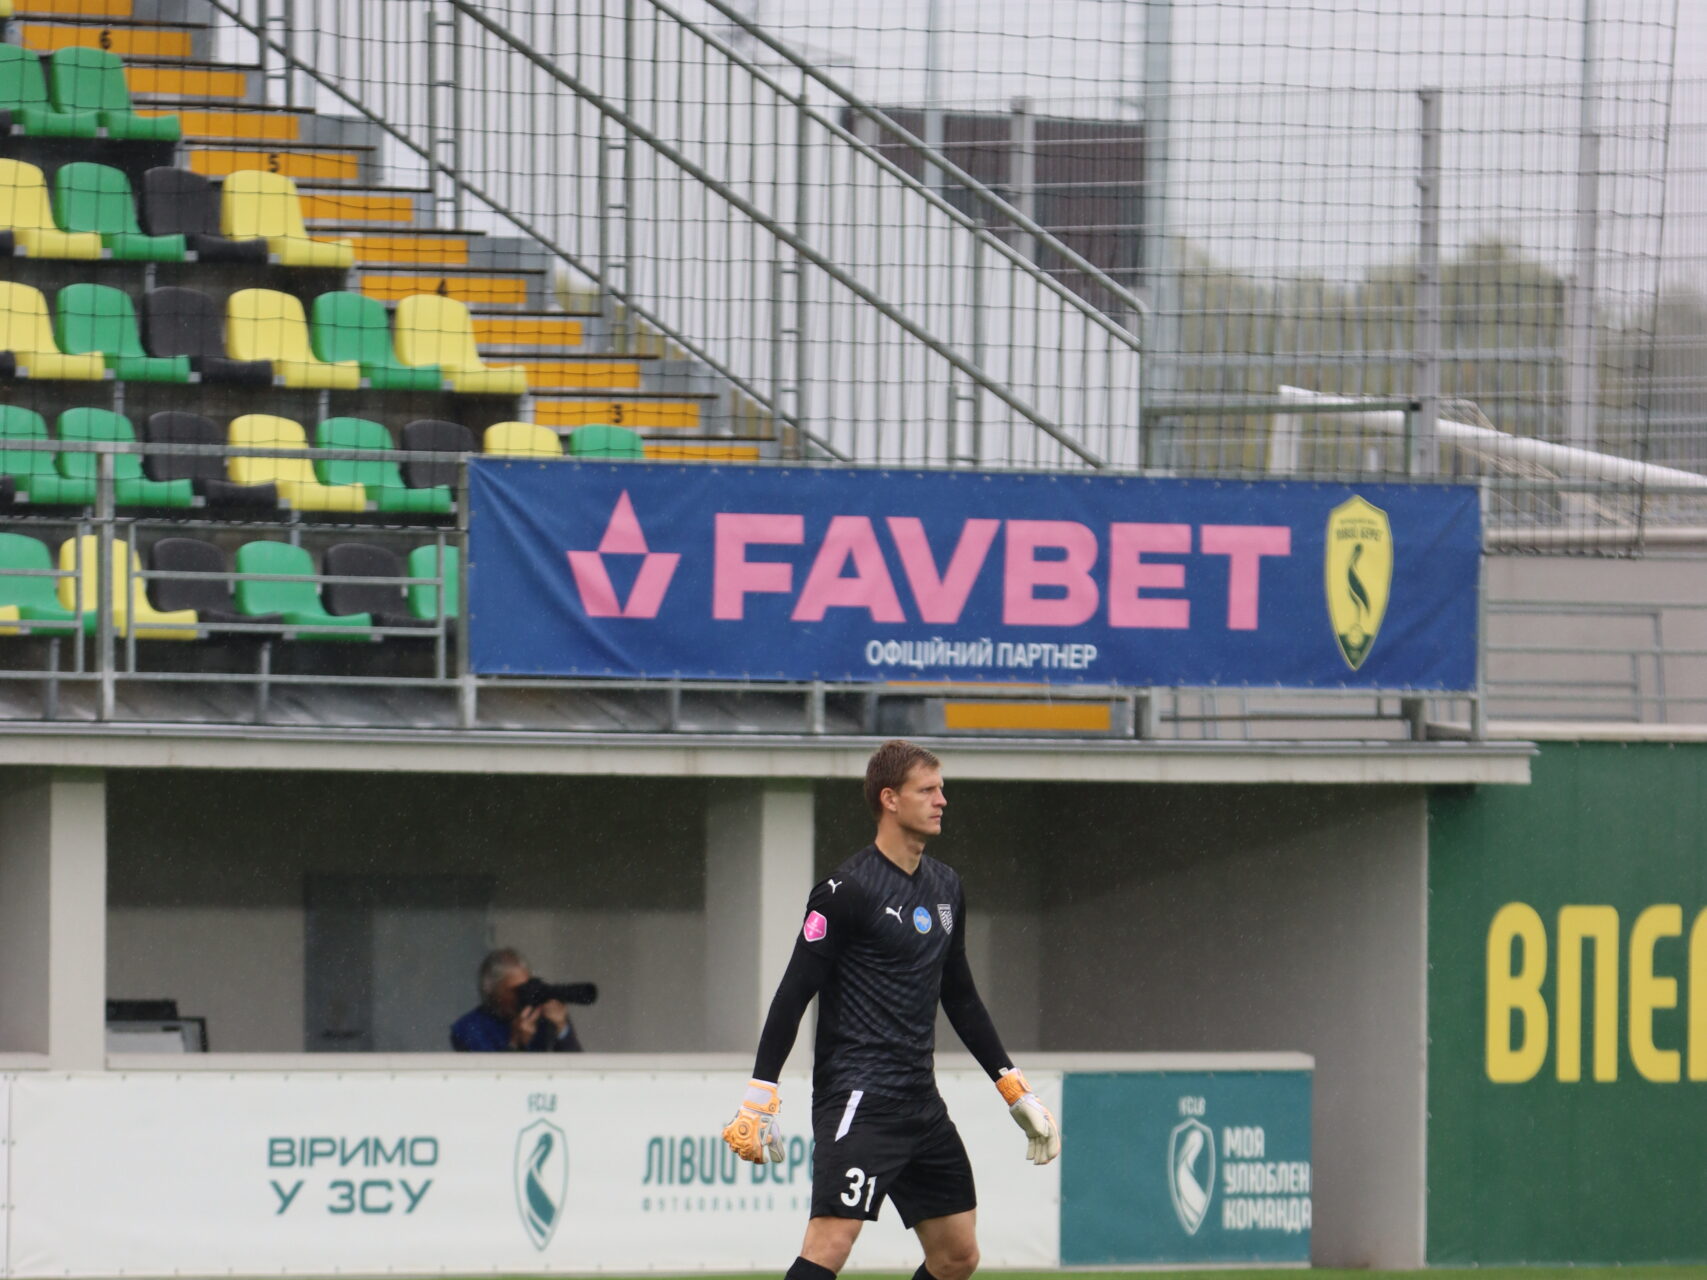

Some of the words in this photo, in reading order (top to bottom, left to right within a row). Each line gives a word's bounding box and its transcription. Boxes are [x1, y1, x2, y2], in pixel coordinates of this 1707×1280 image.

[712, 512, 1291, 630] FAVBET
[865, 636, 993, 670] ОФІЦІЙНИЙ
[996, 641, 1098, 669] ПАРТНЕР
[267, 1136, 440, 1168] ВІРИМО
[1223, 1126, 1265, 1158] МОЯ
[841, 1167, 877, 1212] 31
[1223, 1161, 1312, 1194] УЛЮБЛЕН
[268, 1179, 305, 1215] У
[327, 1179, 434, 1214] ЗСУ
[1223, 1197, 1312, 1233] КОМАНДА
